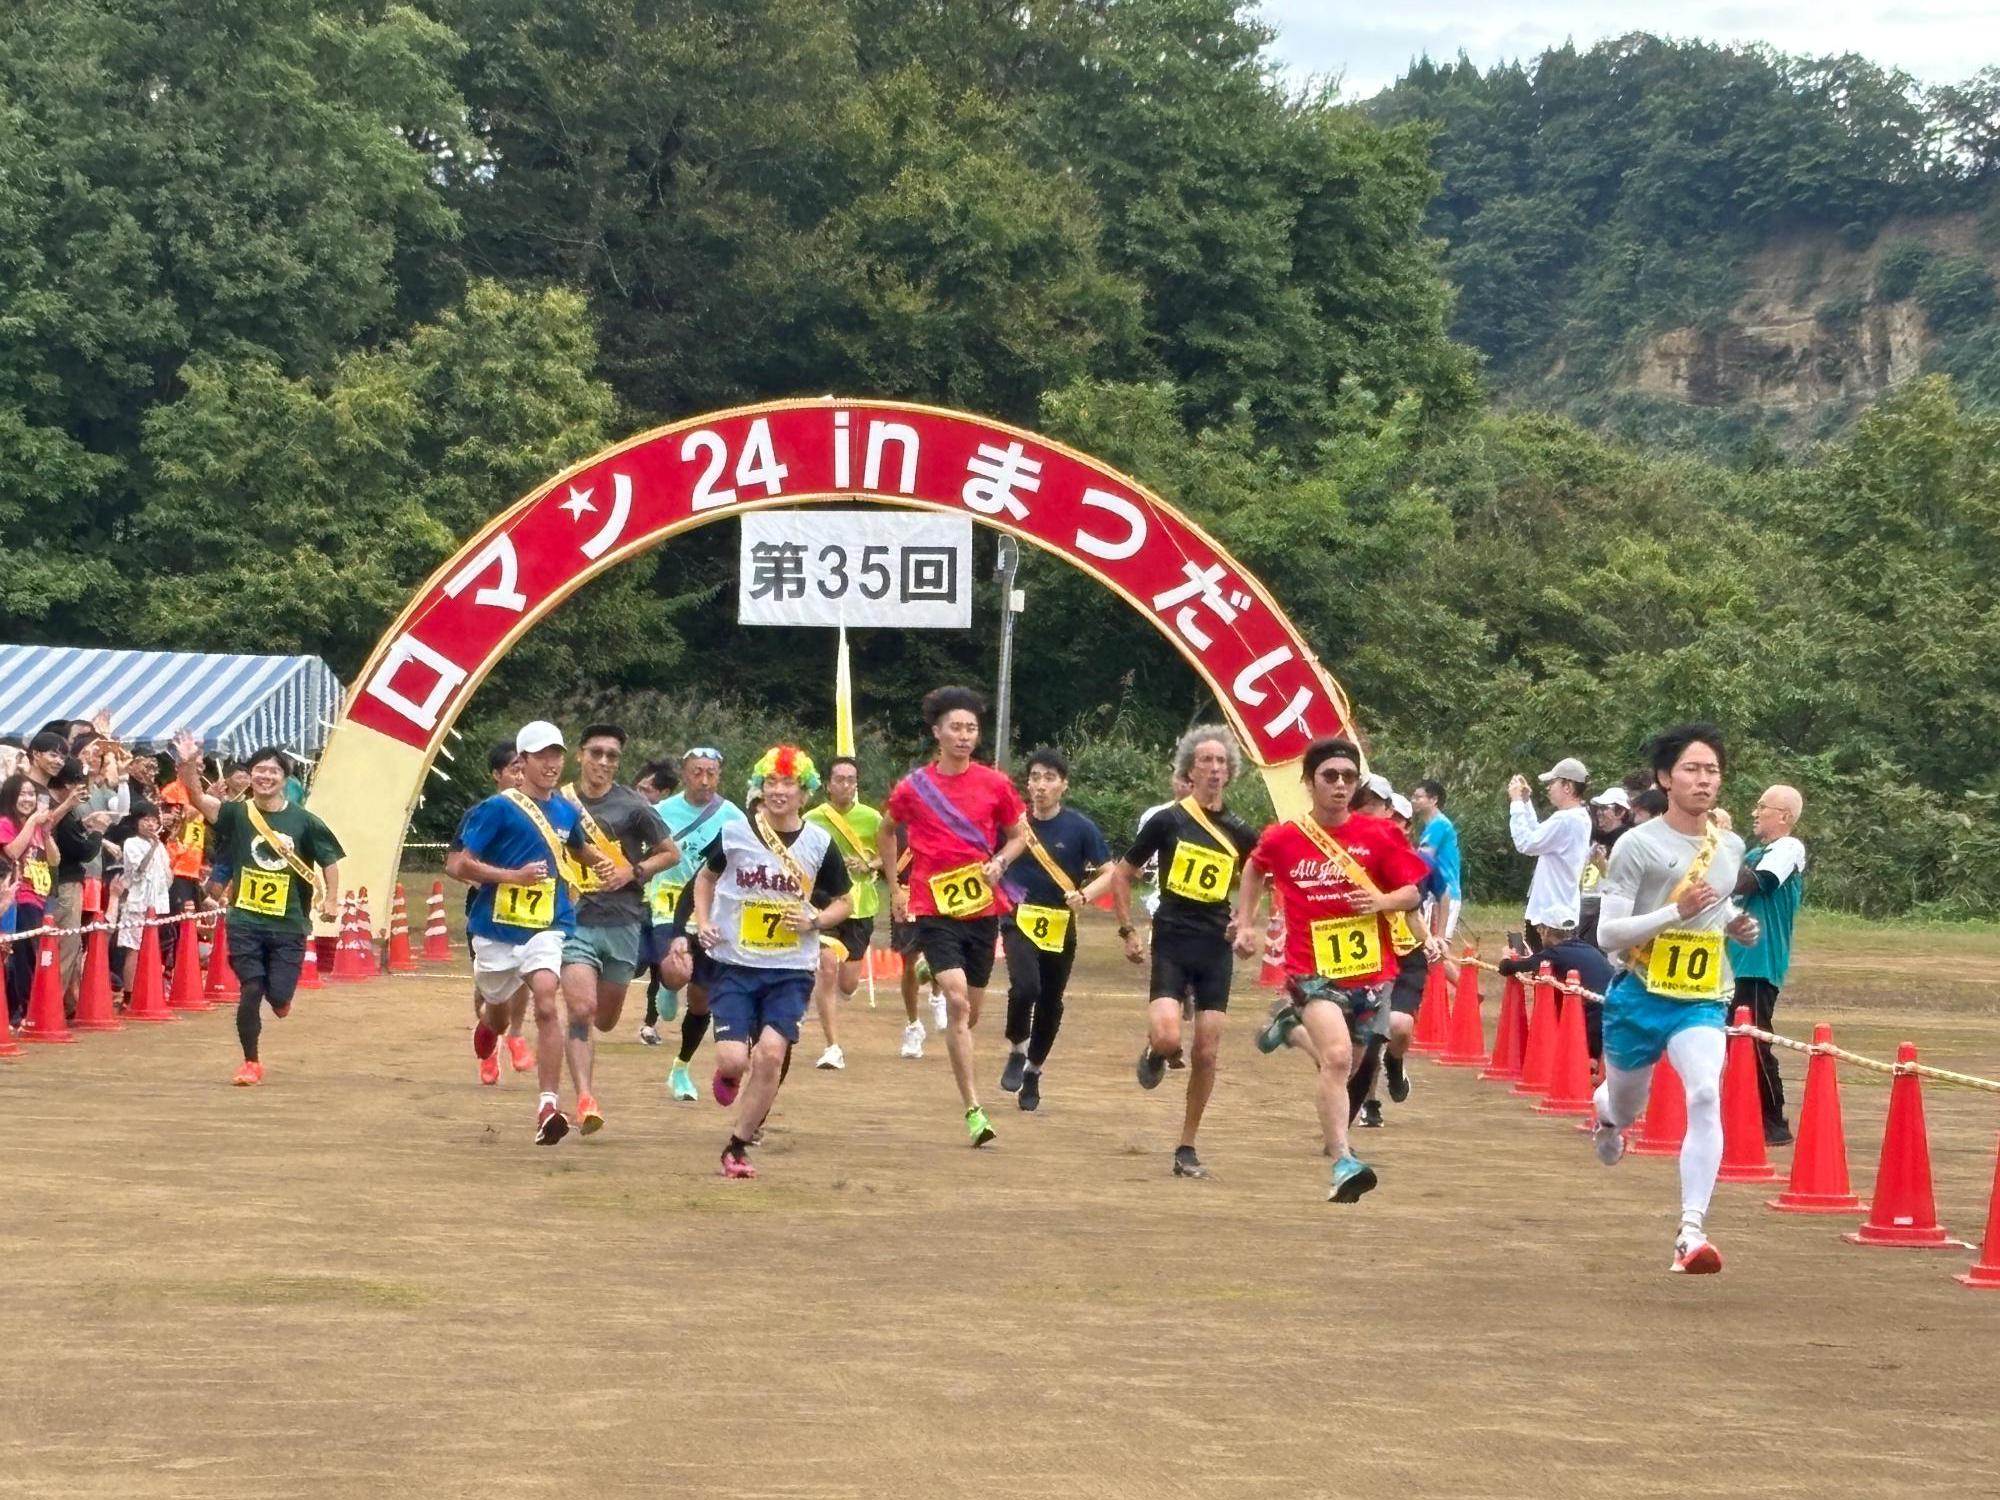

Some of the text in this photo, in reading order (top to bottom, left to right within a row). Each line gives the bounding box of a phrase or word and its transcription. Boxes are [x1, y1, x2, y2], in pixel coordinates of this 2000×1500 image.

[750, 541, 957, 604] 第35回
[1182, 857, 1220, 890] 16
[249, 879, 278, 904] 12
[508, 888, 543, 916] 17
[944, 876, 983, 909] 20
[762, 912, 782, 940] 7
[1033, 916, 1050, 940] 8
[1327, 929, 1369, 964] 13
[1666, 944, 1709, 980] 10
